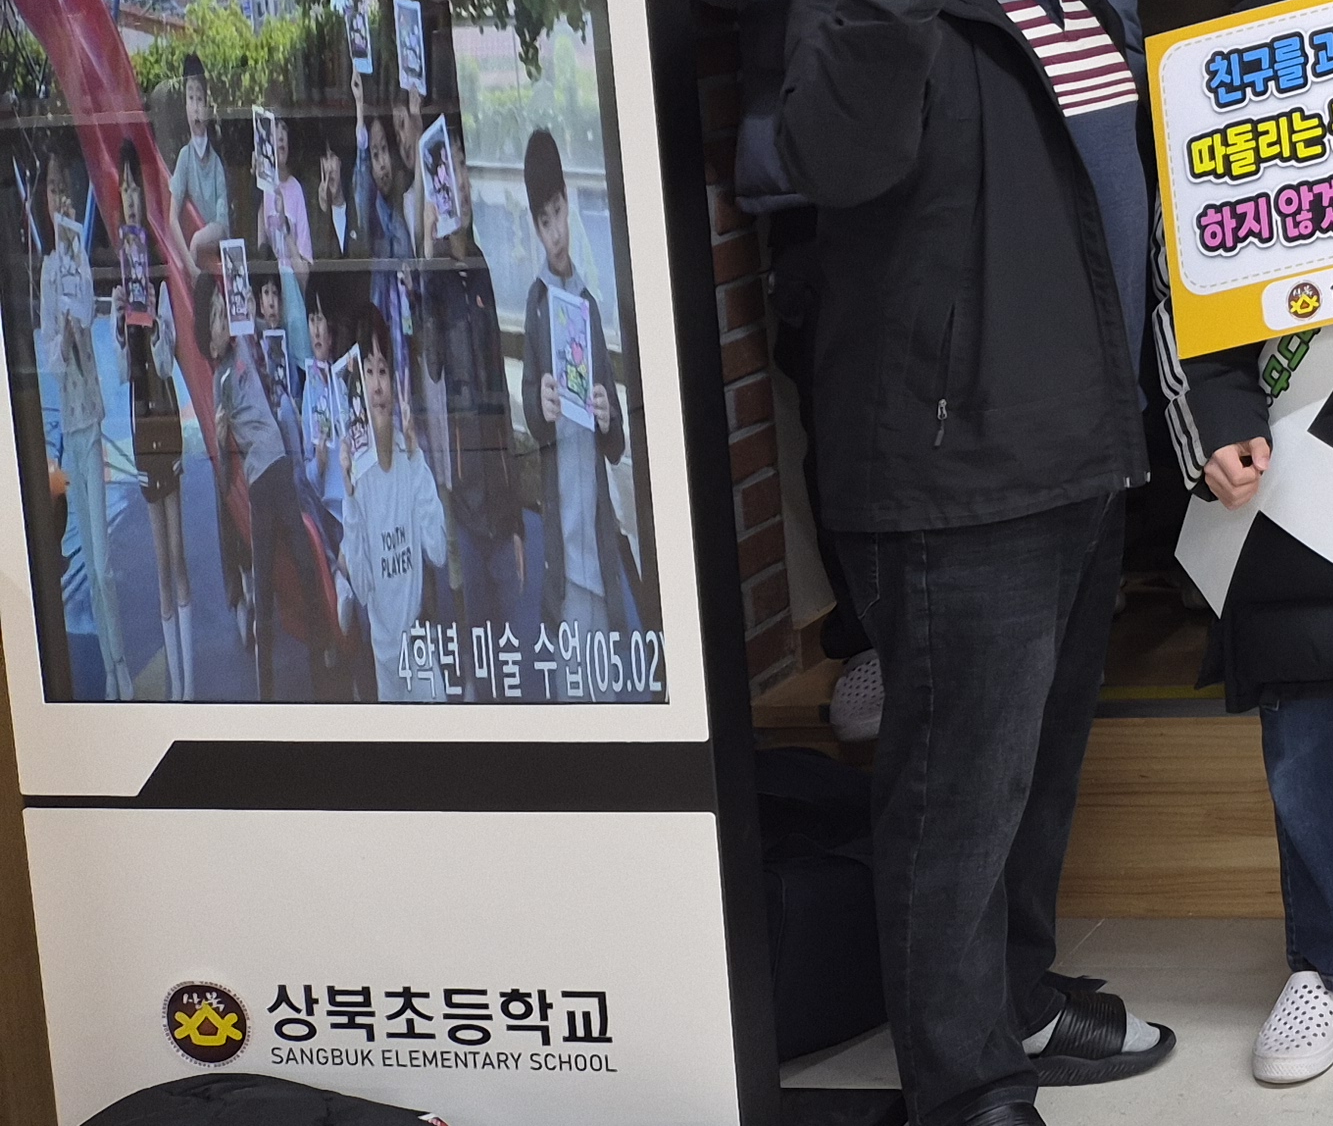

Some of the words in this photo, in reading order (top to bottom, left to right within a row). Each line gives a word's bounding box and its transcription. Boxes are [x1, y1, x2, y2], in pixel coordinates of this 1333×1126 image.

[1205, 32, 1309, 108] 친구를
[1188, 106, 1326, 181] 따돌리는
[1197, 192, 1273, 254] 하지
[381, 526, 406, 552] YOUTH
[381, 547, 413, 579] PLAYER
[398, 619, 463, 699] 4학년
[471, 620, 522, 699] 미술
[266, 983, 613, 1048] 상북초등학교
[270, 1046, 376, 1068] SANGBUK
[380, 1049, 521, 1072] ELEMENTARY
[529, 1052, 619, 1074] SCHOOL
